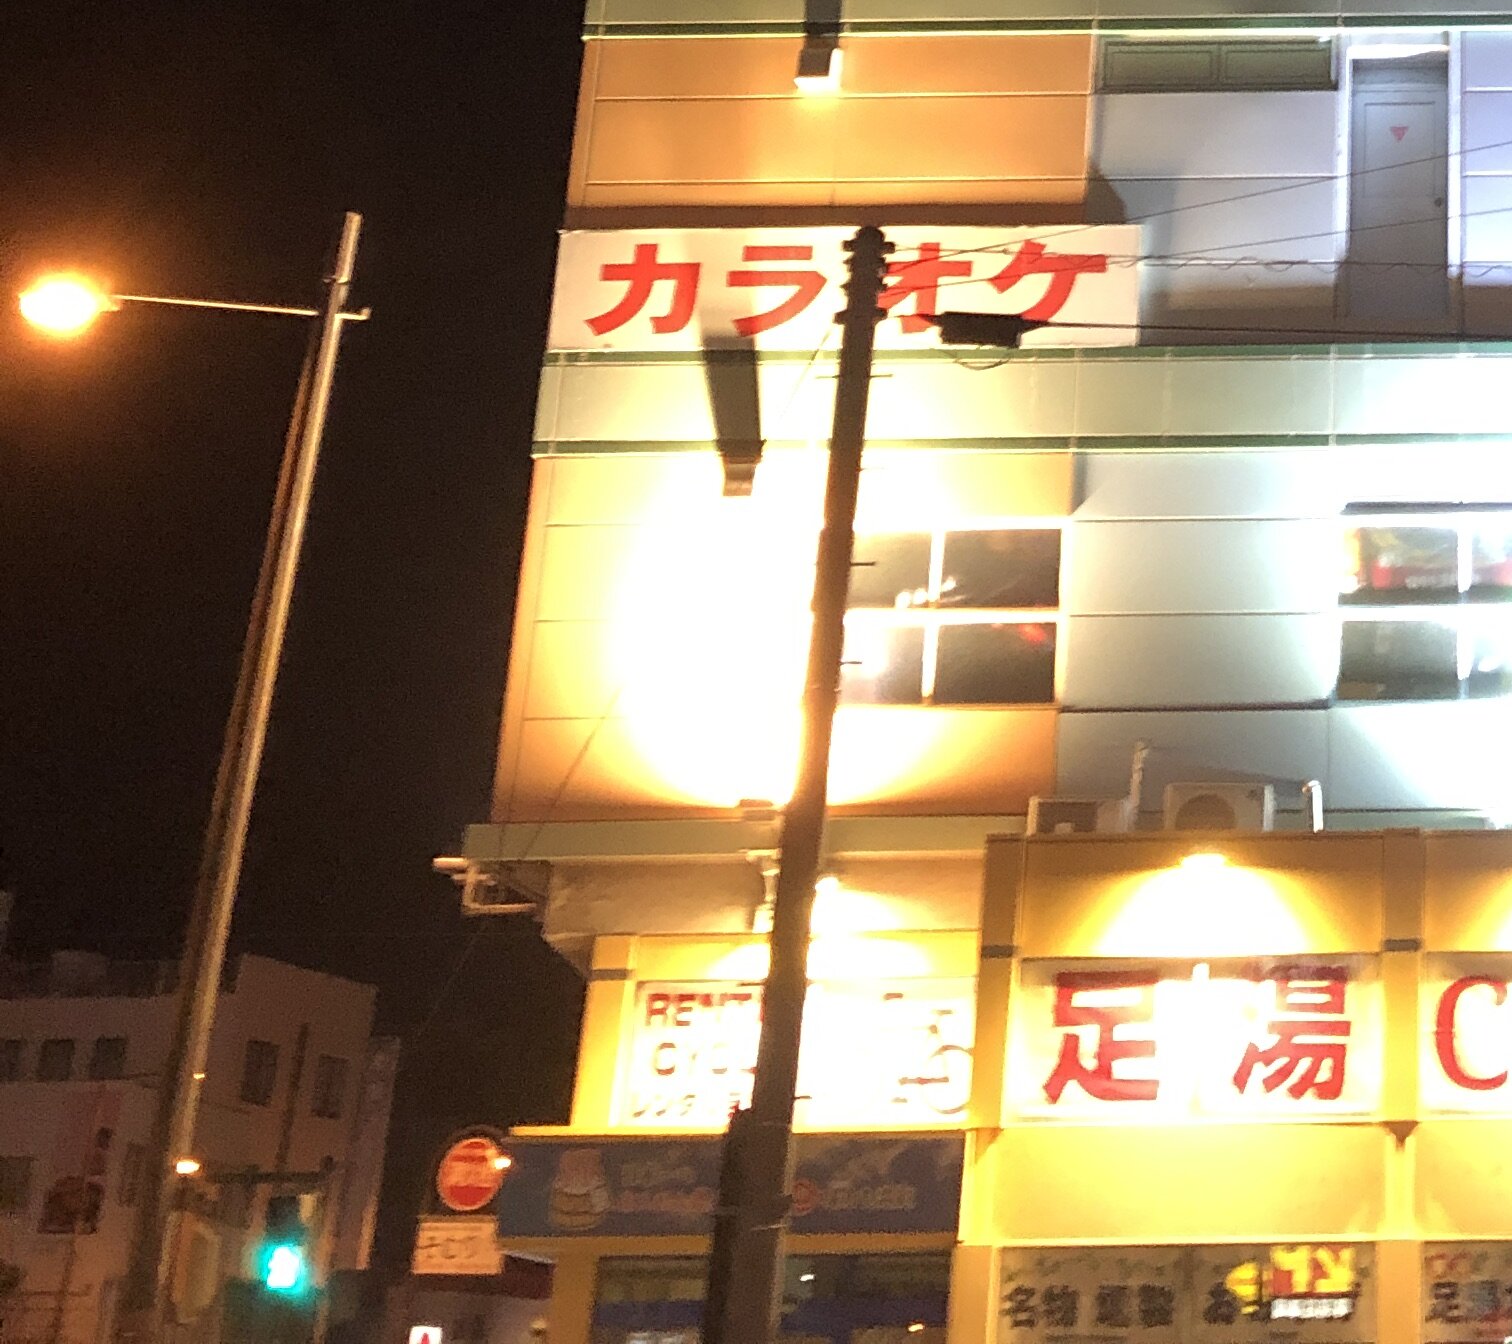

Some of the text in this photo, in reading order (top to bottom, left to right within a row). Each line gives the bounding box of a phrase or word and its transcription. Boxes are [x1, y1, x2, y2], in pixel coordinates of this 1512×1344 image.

[585, 242, 1108, 337] カラオケ
[1042, 966, 1351, 1105] 足湯
